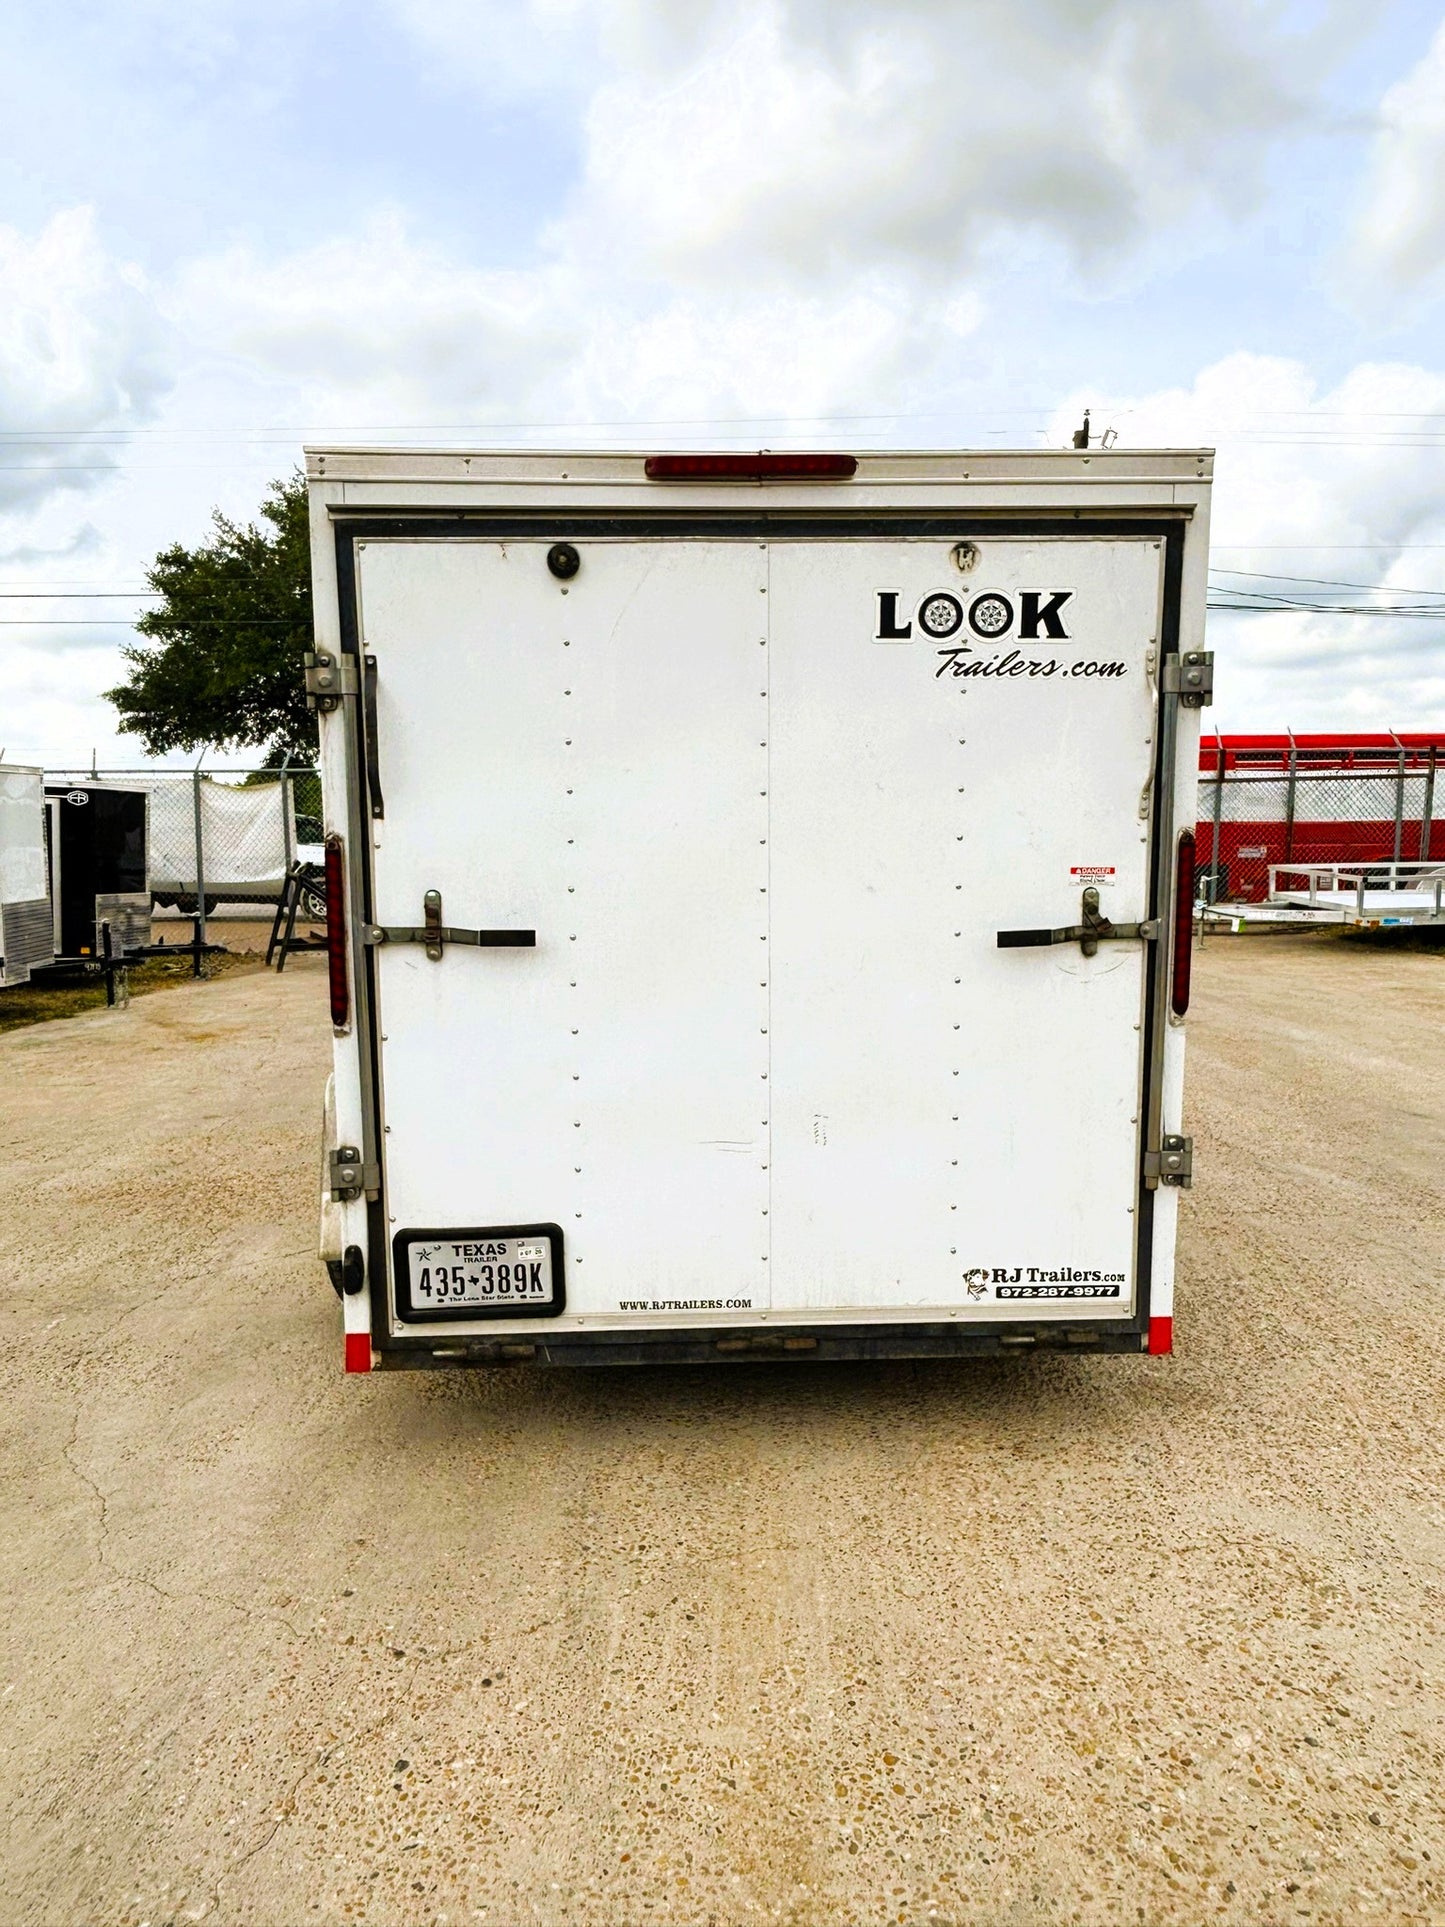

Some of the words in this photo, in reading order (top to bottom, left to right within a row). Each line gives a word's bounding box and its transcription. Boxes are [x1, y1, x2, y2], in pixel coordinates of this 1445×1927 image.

[876, 592, 1073, 639] LOOK
[935, 648, 1128, 679] Trailers.com
[1081, 867, 1110, 875] DANGER
[451, 1243, 507, 1257] TEXAS
[991, 1268, 1023, 1283] RJ
[1001, 1286, 1116, 1298] 972-287-9977
[619, 1299, 753, 1310] WWW.RJTRAILERS.COM
